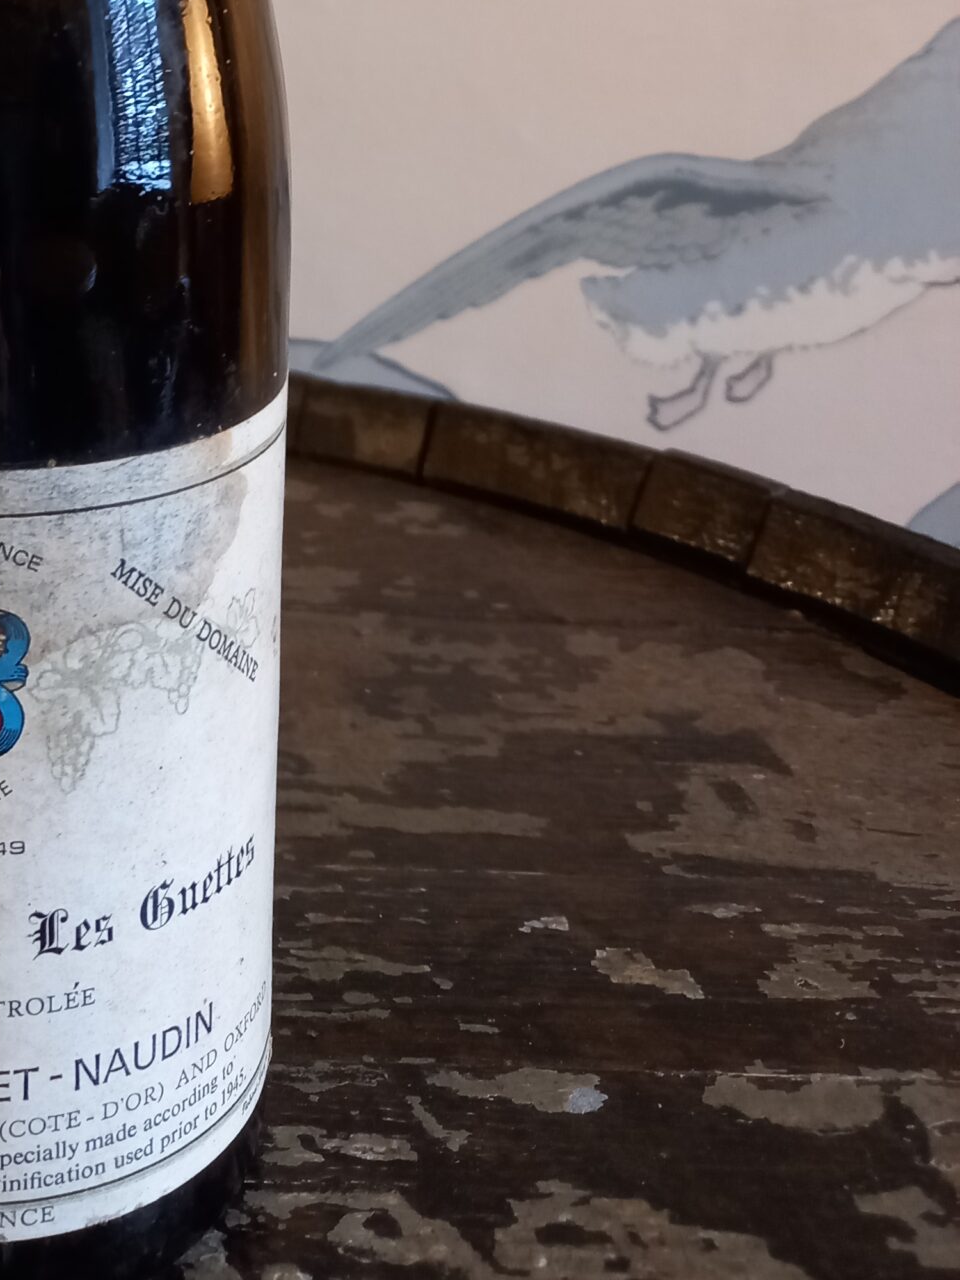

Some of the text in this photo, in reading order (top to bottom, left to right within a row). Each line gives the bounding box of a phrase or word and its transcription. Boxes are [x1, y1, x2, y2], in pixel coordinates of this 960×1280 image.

[110, 558, 259, 682] MISE DU DOMAINE
[26, 908, 114, 960] Les
[139, 833, 255, 931] Guettes
[175, 1048, 218, 1090] AND
[223, 980, 267, 1053] OXFORD
[85, 1122, 137, 1152] made
[143, 1075, 218, 1132] according
[222, 1061, 234, 1081] to
[114, 1138, 154, 1169] used
[159, 1115, 200, 1155] prior
[204, 1101, 217, 1121] to
[221, 1067, 247, 1106] 1945.
